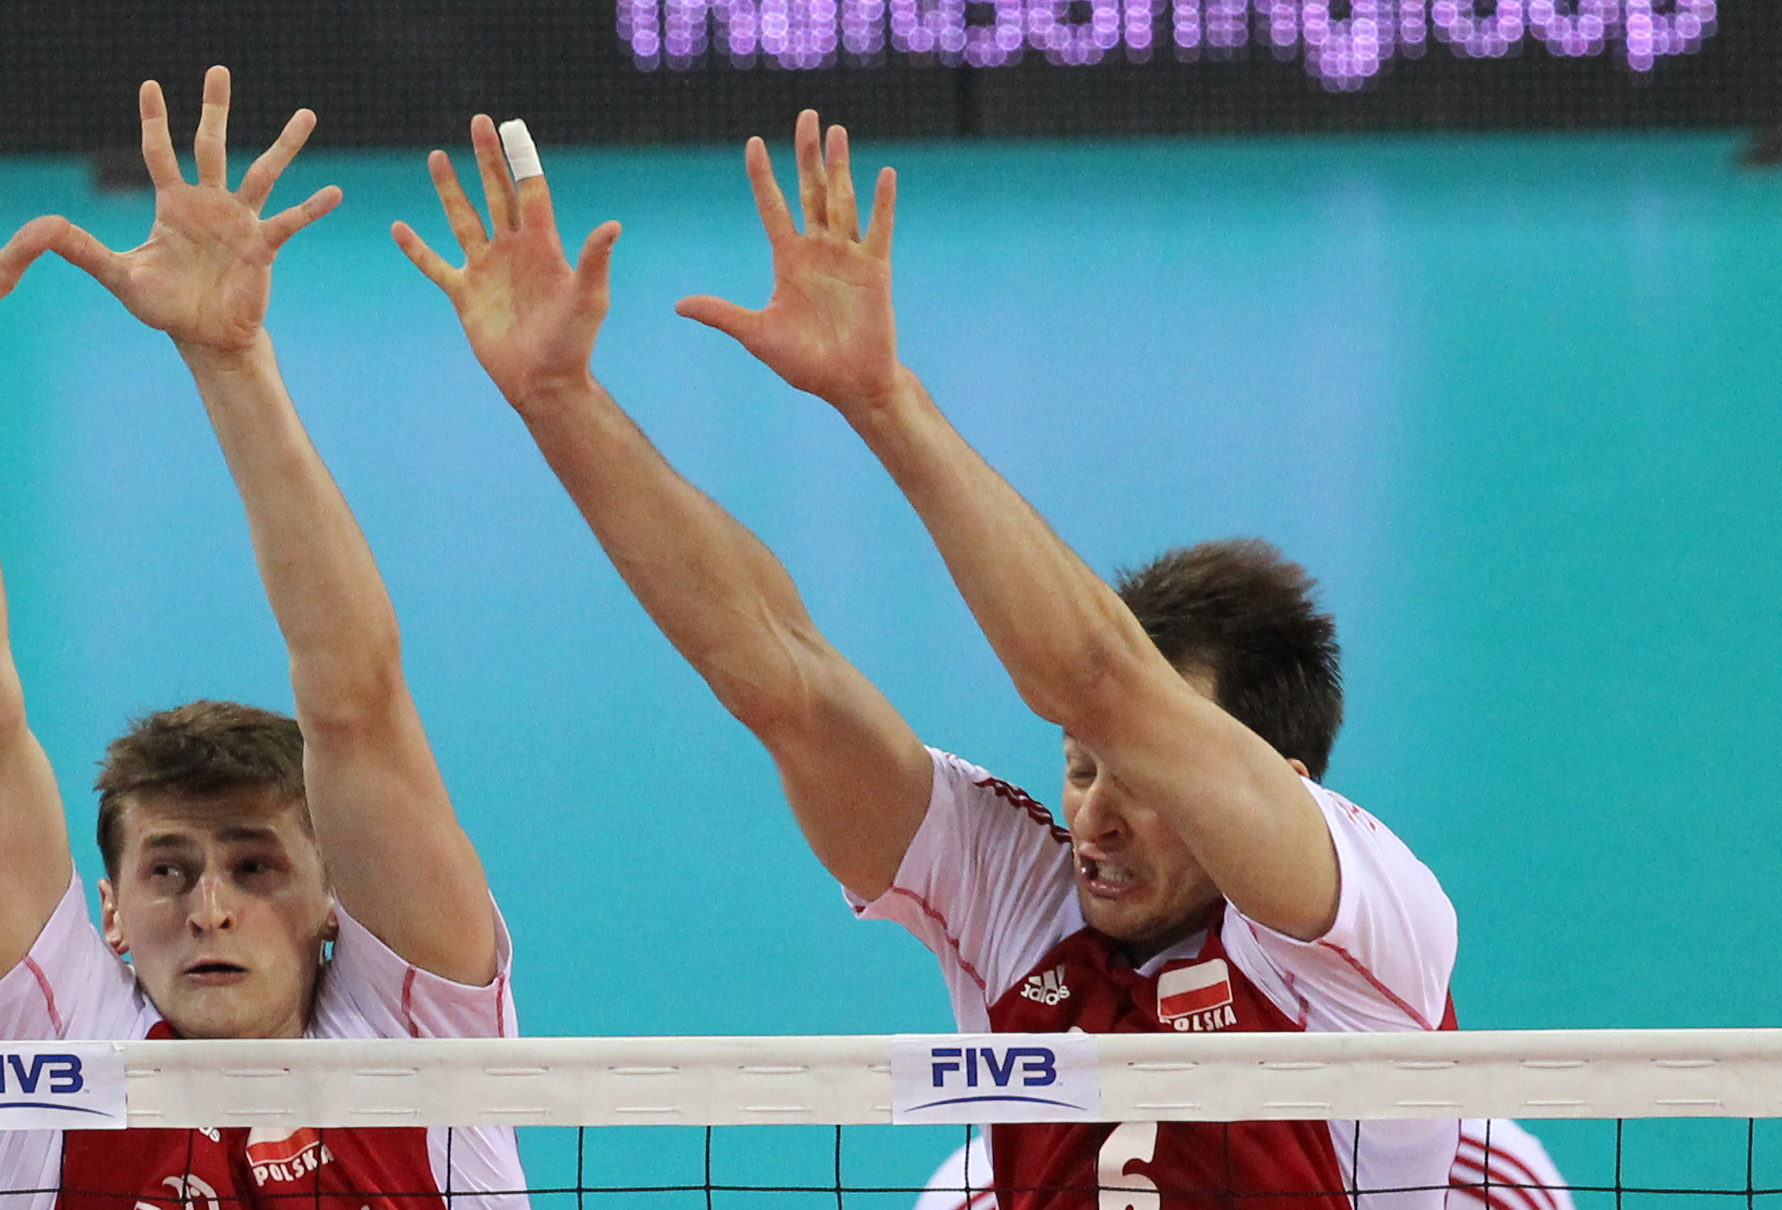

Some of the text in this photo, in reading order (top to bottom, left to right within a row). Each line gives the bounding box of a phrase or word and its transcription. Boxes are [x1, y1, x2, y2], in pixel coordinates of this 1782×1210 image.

[1159, 1005, 1237, 1032] OLSKA
[930, 1046, 1057, 1088] FIVB
[253, 1144, 335, 1187] POLSKA
